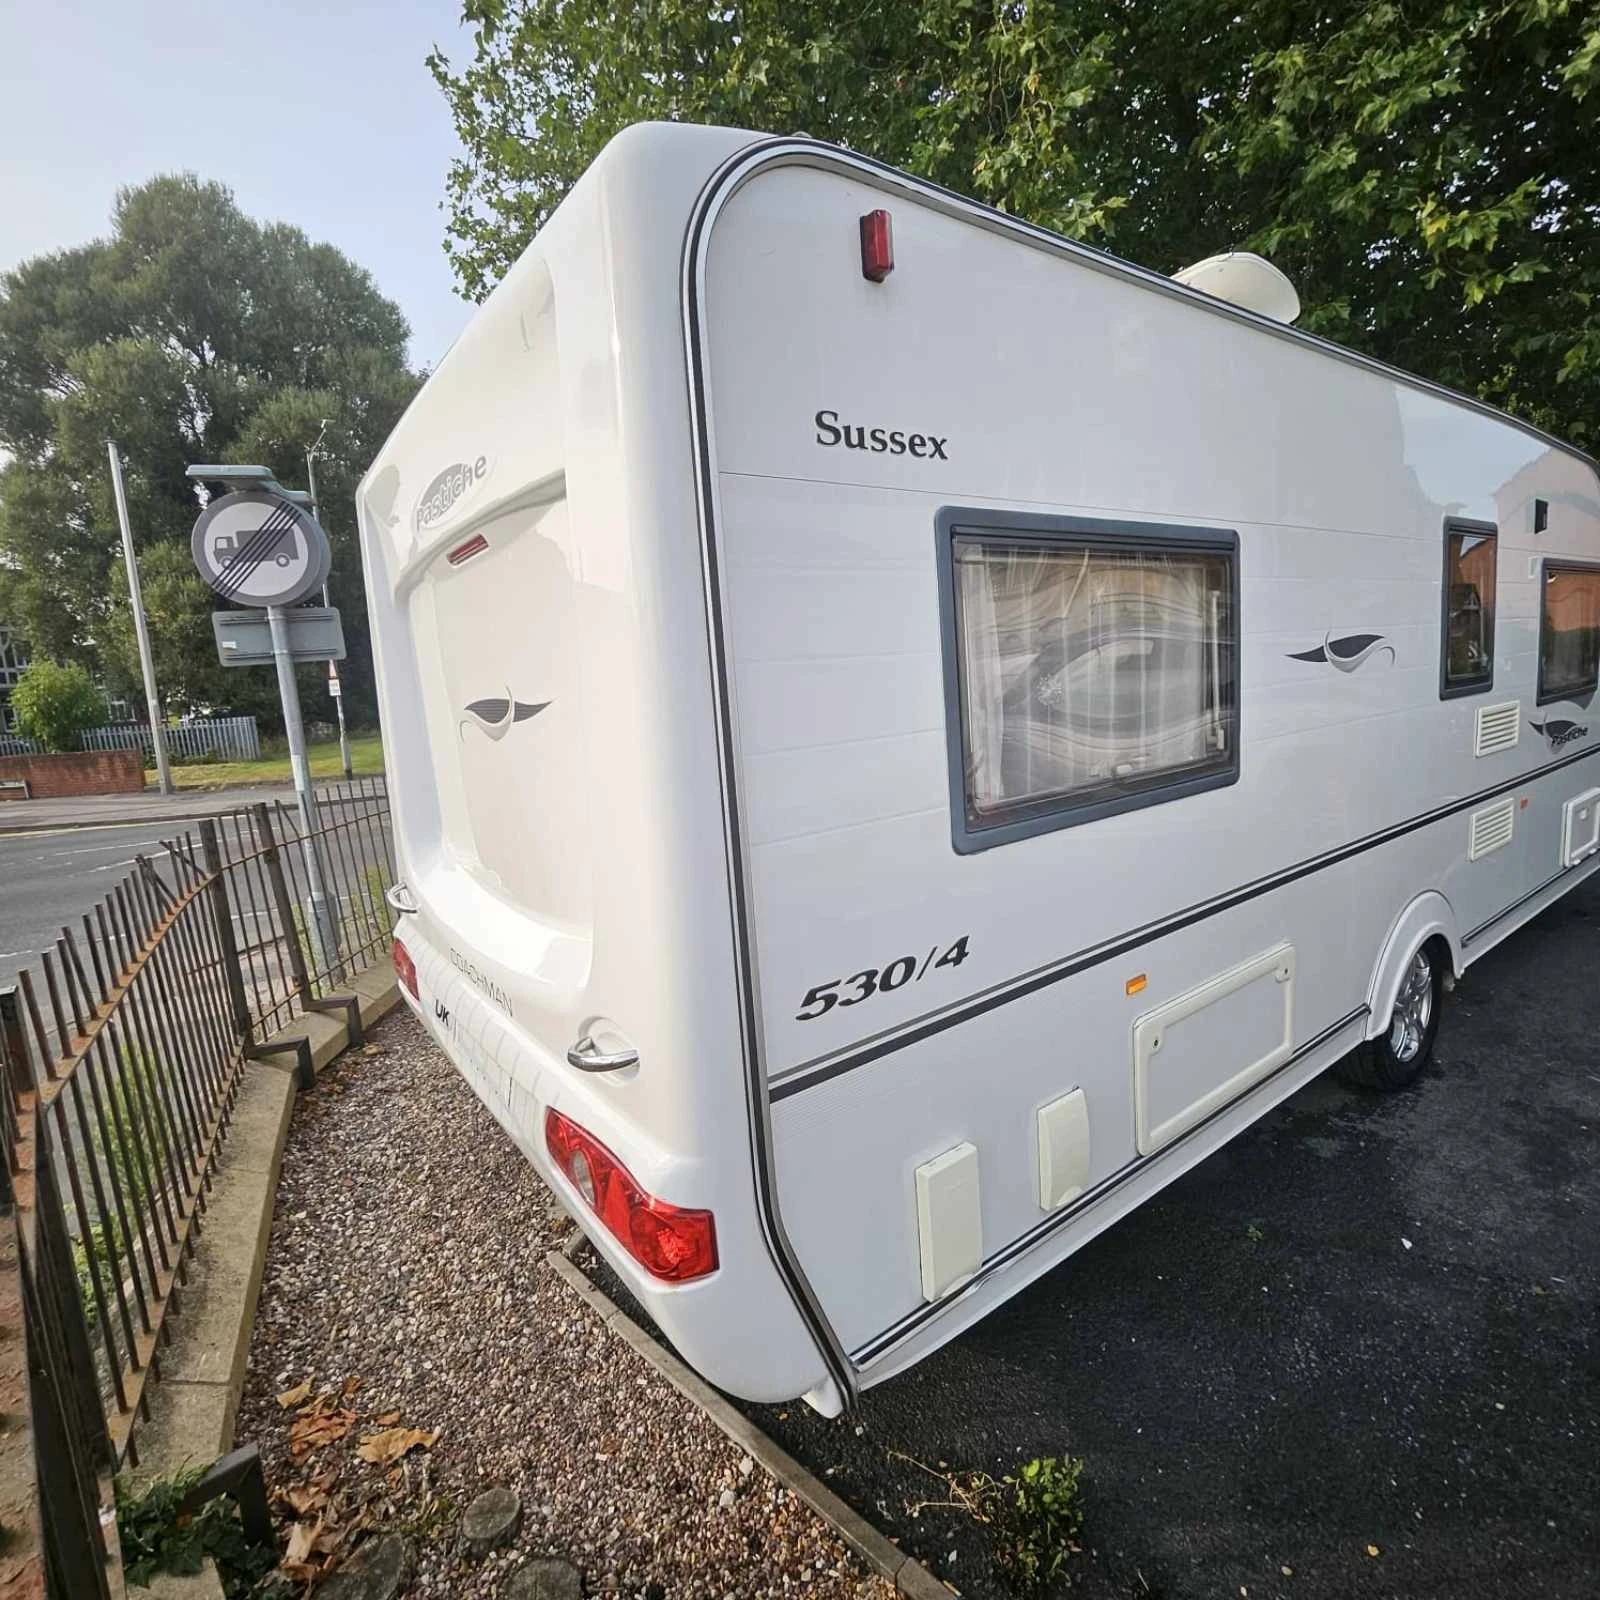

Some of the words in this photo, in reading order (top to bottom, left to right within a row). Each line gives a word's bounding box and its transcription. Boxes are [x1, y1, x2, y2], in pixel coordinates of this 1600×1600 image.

[815, 410, 949, 460] Sussex
[449, 947, 513, 1017] COACHMAN
[795, 935, 970, 1021] 530/4
[434, 999, 449, 1027] UK
